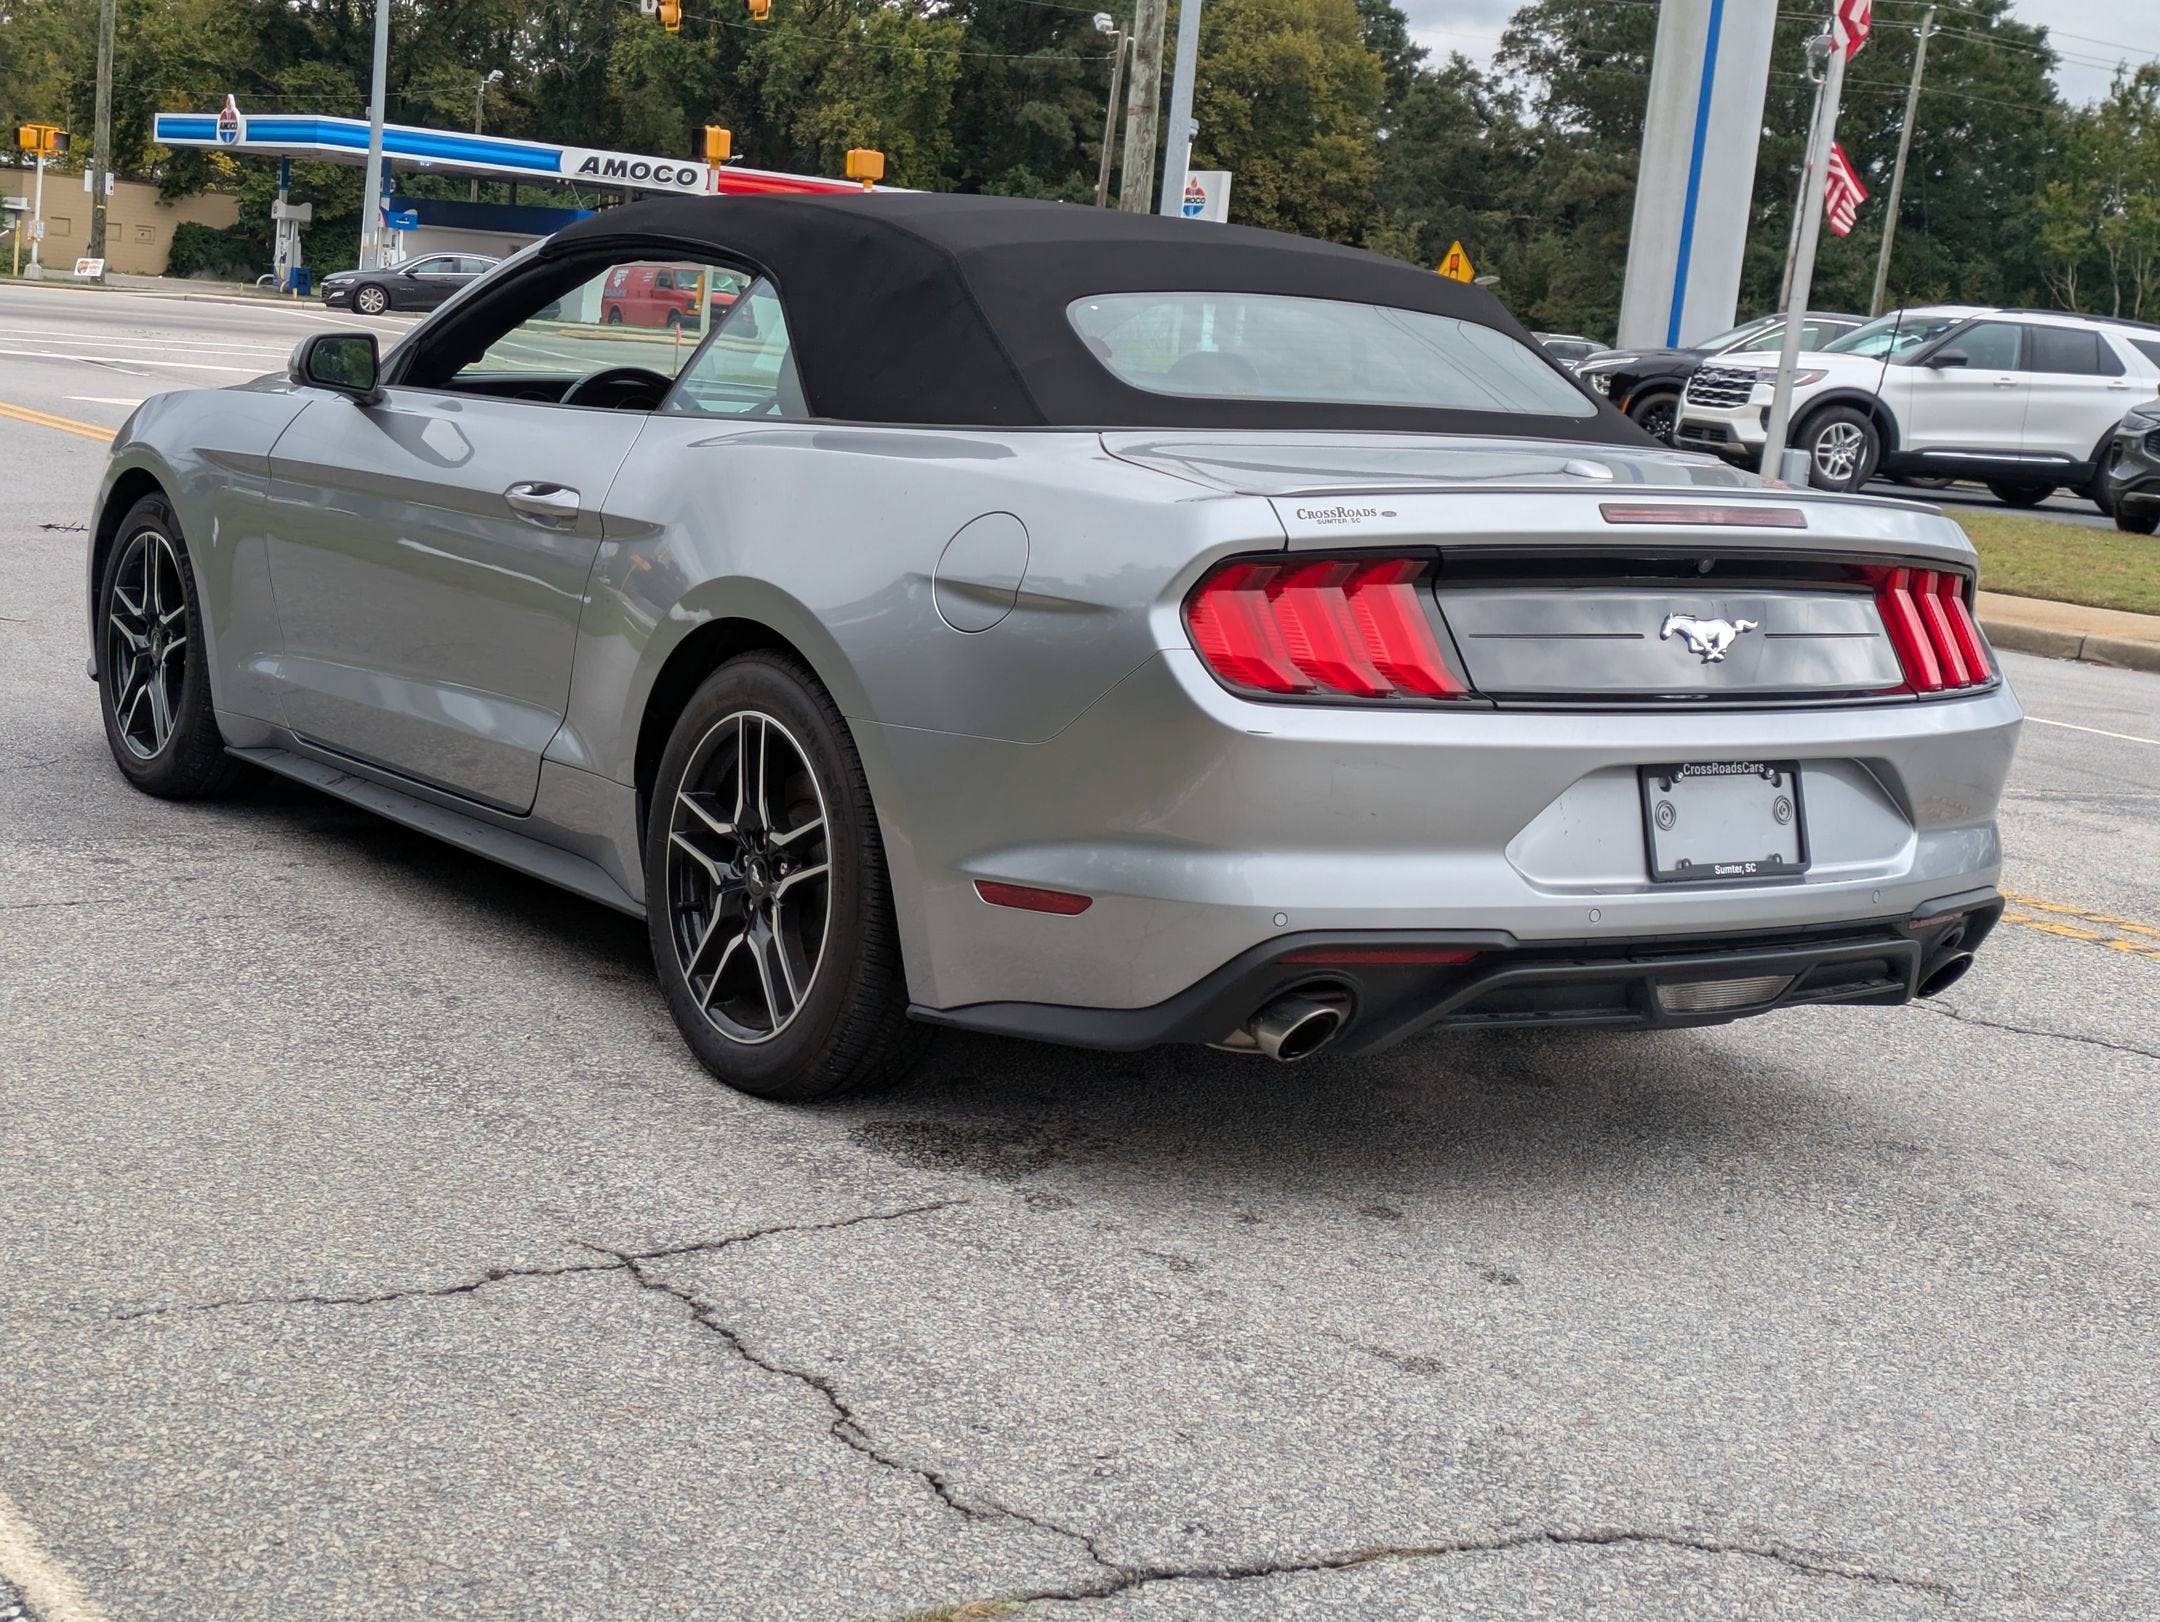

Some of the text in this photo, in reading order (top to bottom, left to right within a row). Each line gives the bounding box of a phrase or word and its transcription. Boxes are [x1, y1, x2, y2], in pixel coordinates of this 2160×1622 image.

[577, 155, 699, 187] AMOCO
[1183, 197, 1206, 205] MOCO
[1682, 761, 1765, 775] CrossRoadsCars
[1714, 863, 1757, 875] Sumter, SC
